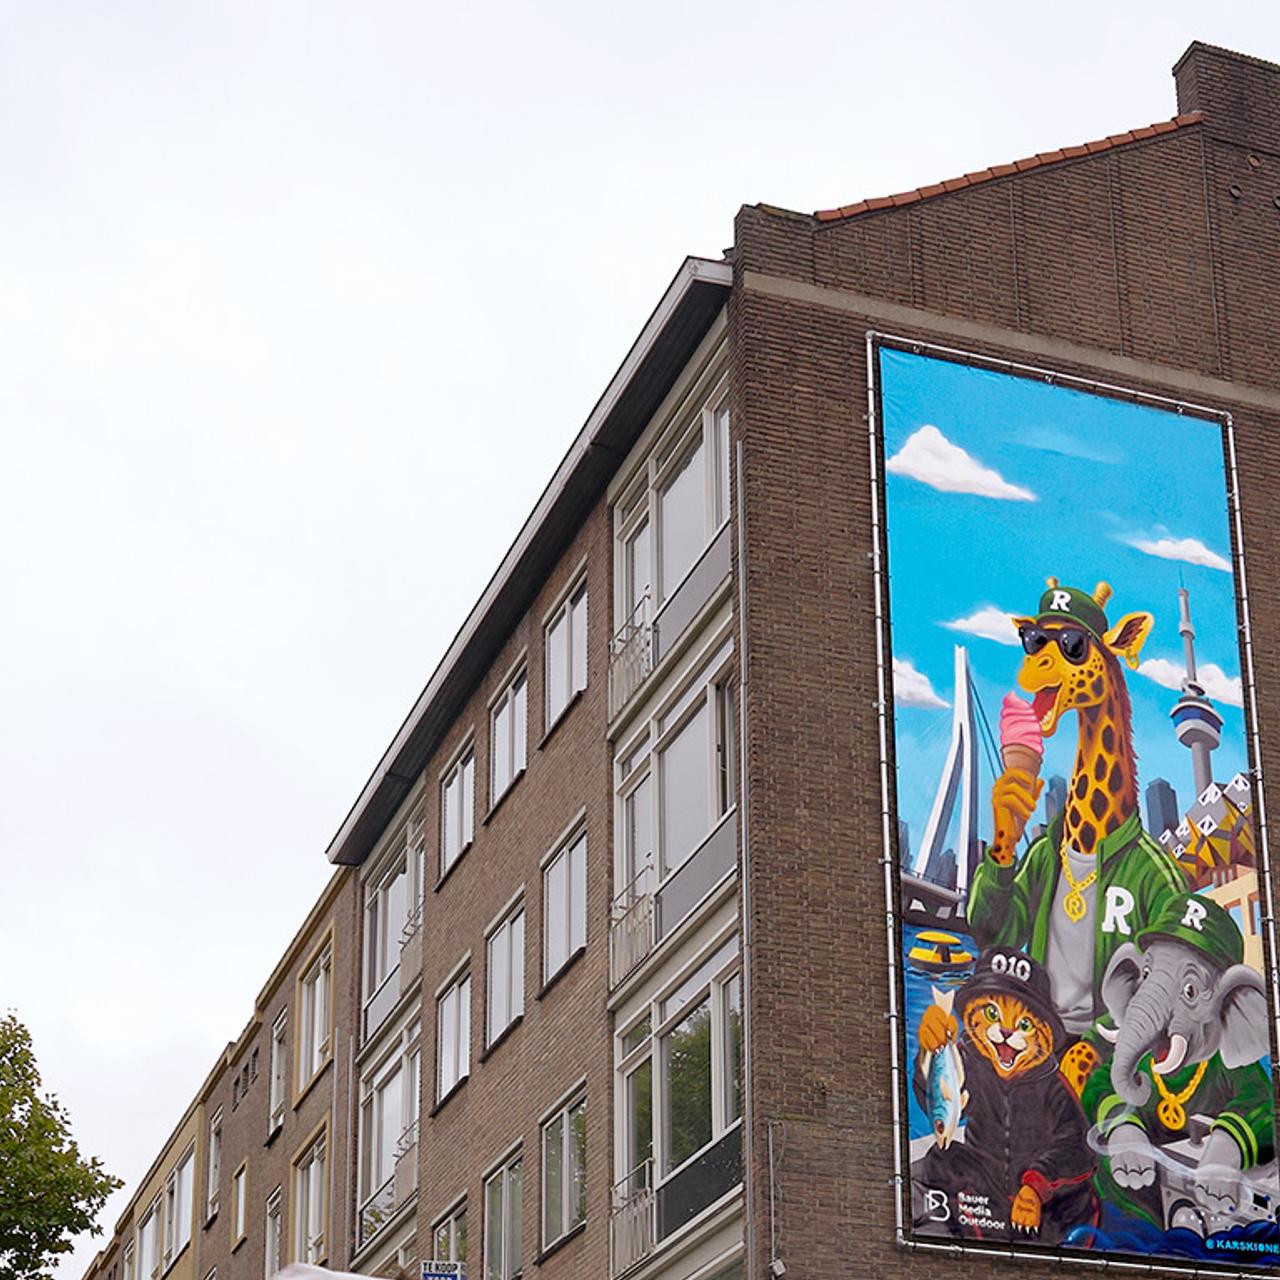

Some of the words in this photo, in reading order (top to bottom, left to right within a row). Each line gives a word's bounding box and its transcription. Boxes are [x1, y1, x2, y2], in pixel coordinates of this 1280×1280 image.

[1049, 590, 1072, 612] R
[1069, 899, 1080, 913] R
[1101, 886, 1135, 935] R
[1180, 899, 1208, 931] R
[991, 954, 1032, 982] 010
[958, 1191, 990, 1206] Bauer
[958, 1203, 992, 1217] Media
[958, 1214, 1006, 1230] Outdoor
[1216, 1239, 1280, 1255] KARSKIONE
